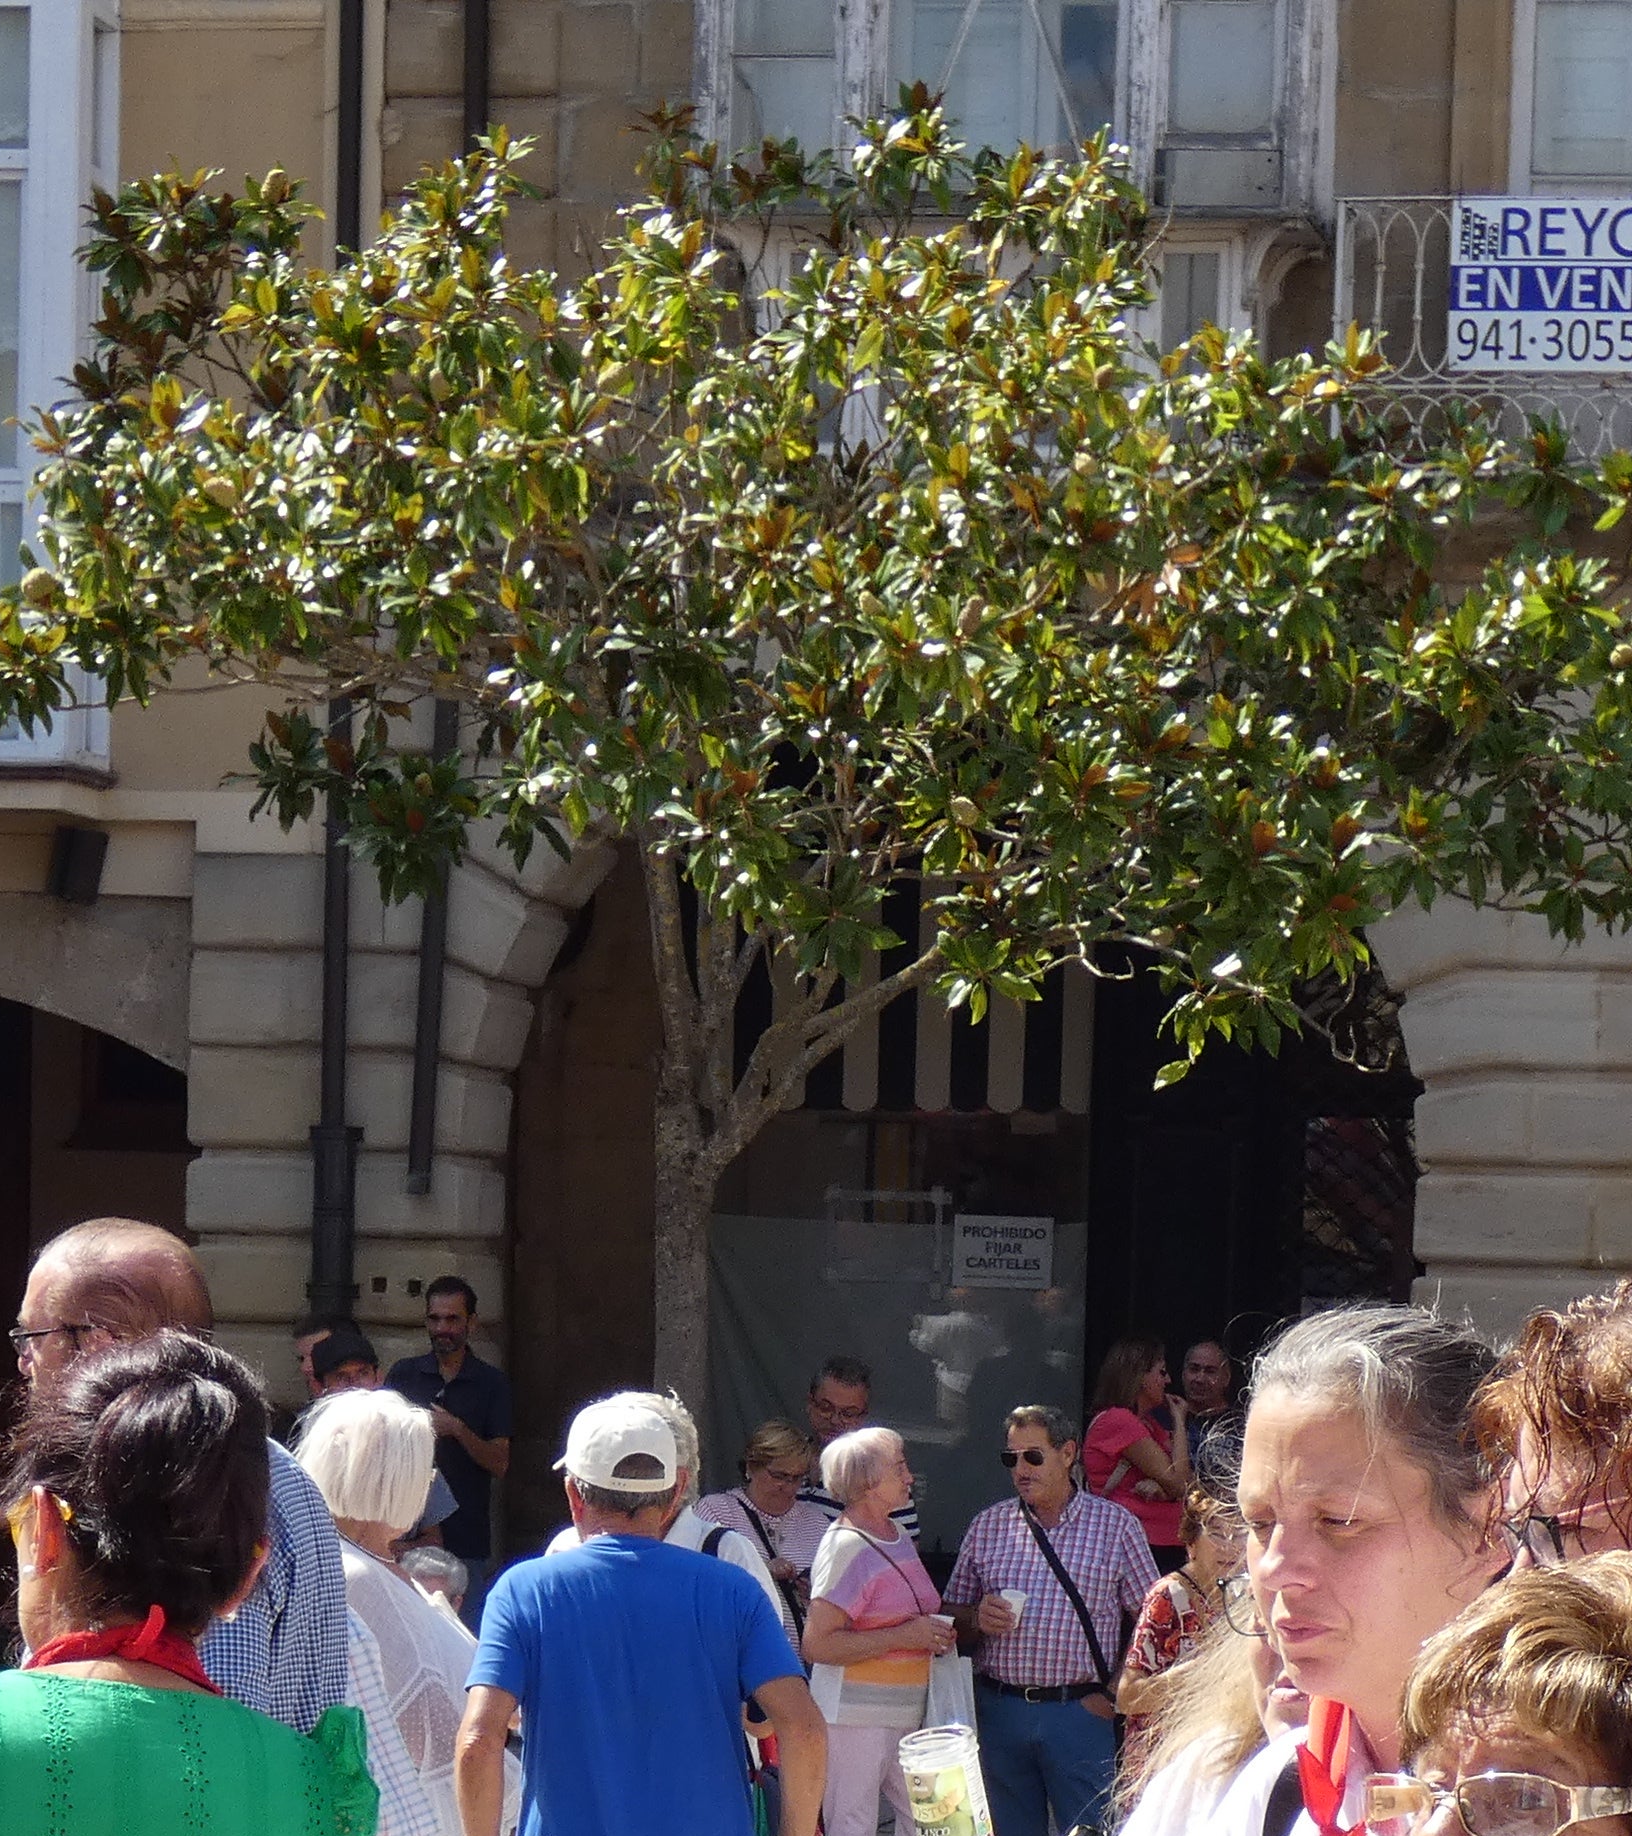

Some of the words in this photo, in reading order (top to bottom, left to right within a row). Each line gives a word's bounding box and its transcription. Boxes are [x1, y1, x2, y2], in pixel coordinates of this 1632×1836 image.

[1457, 267, 1521, 310] EN
[962, 1225, 1047, 1240] PROHIBIDO
[985, 1241, 1023, 1257] FIJAR
[965, 1256, 1041, 1271] CARTELES
